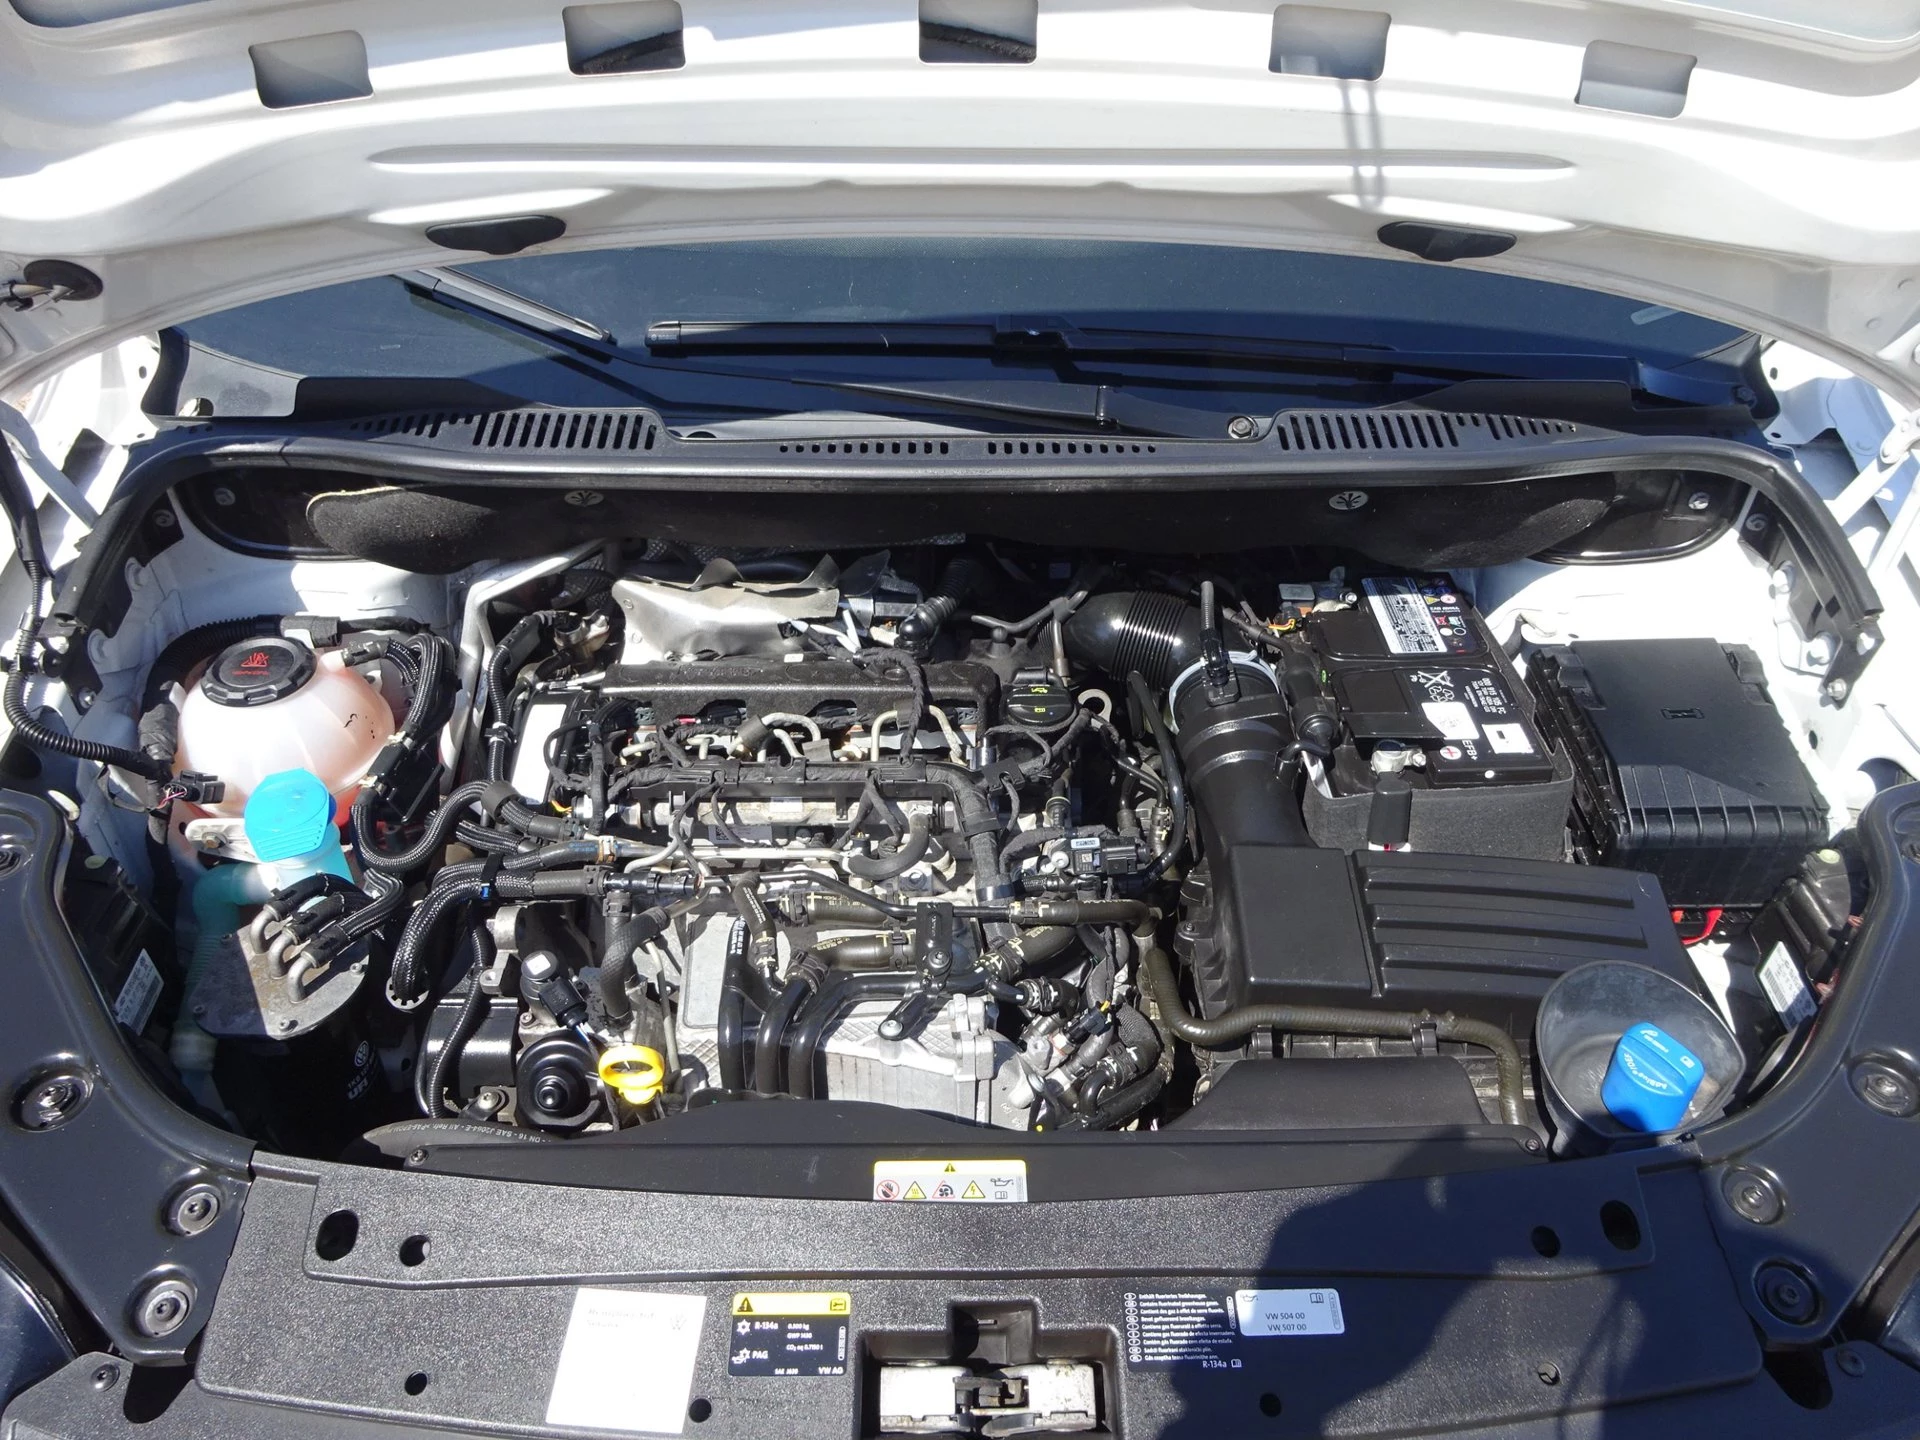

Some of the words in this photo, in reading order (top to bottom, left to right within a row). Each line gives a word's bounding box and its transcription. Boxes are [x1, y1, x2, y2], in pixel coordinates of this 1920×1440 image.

[1461, 739, 1478, 760] EFB+
[495, 1128, 513, 1138] SAE
[518, 1132, 528, 1140] 16
[528, 1135, 541, 1143] DN
[1265, 1312, 1279, 1320] VW
[1280, 1312, 1294, 1320] 504
[1295, 1311, 1306, 1320] 00
[1267, 1323, 1281, 1331] VW
[1282, 1323, 1295, 1331] 507
[1296, 1323, 1307, 1331] 00
[752, 1350, 769, 1359] PAG
[1202, 1360, 1227, 1368] R-134a
[818, 1366, 832, 1375] VW
[832, 1366, 844, 1375] AG
